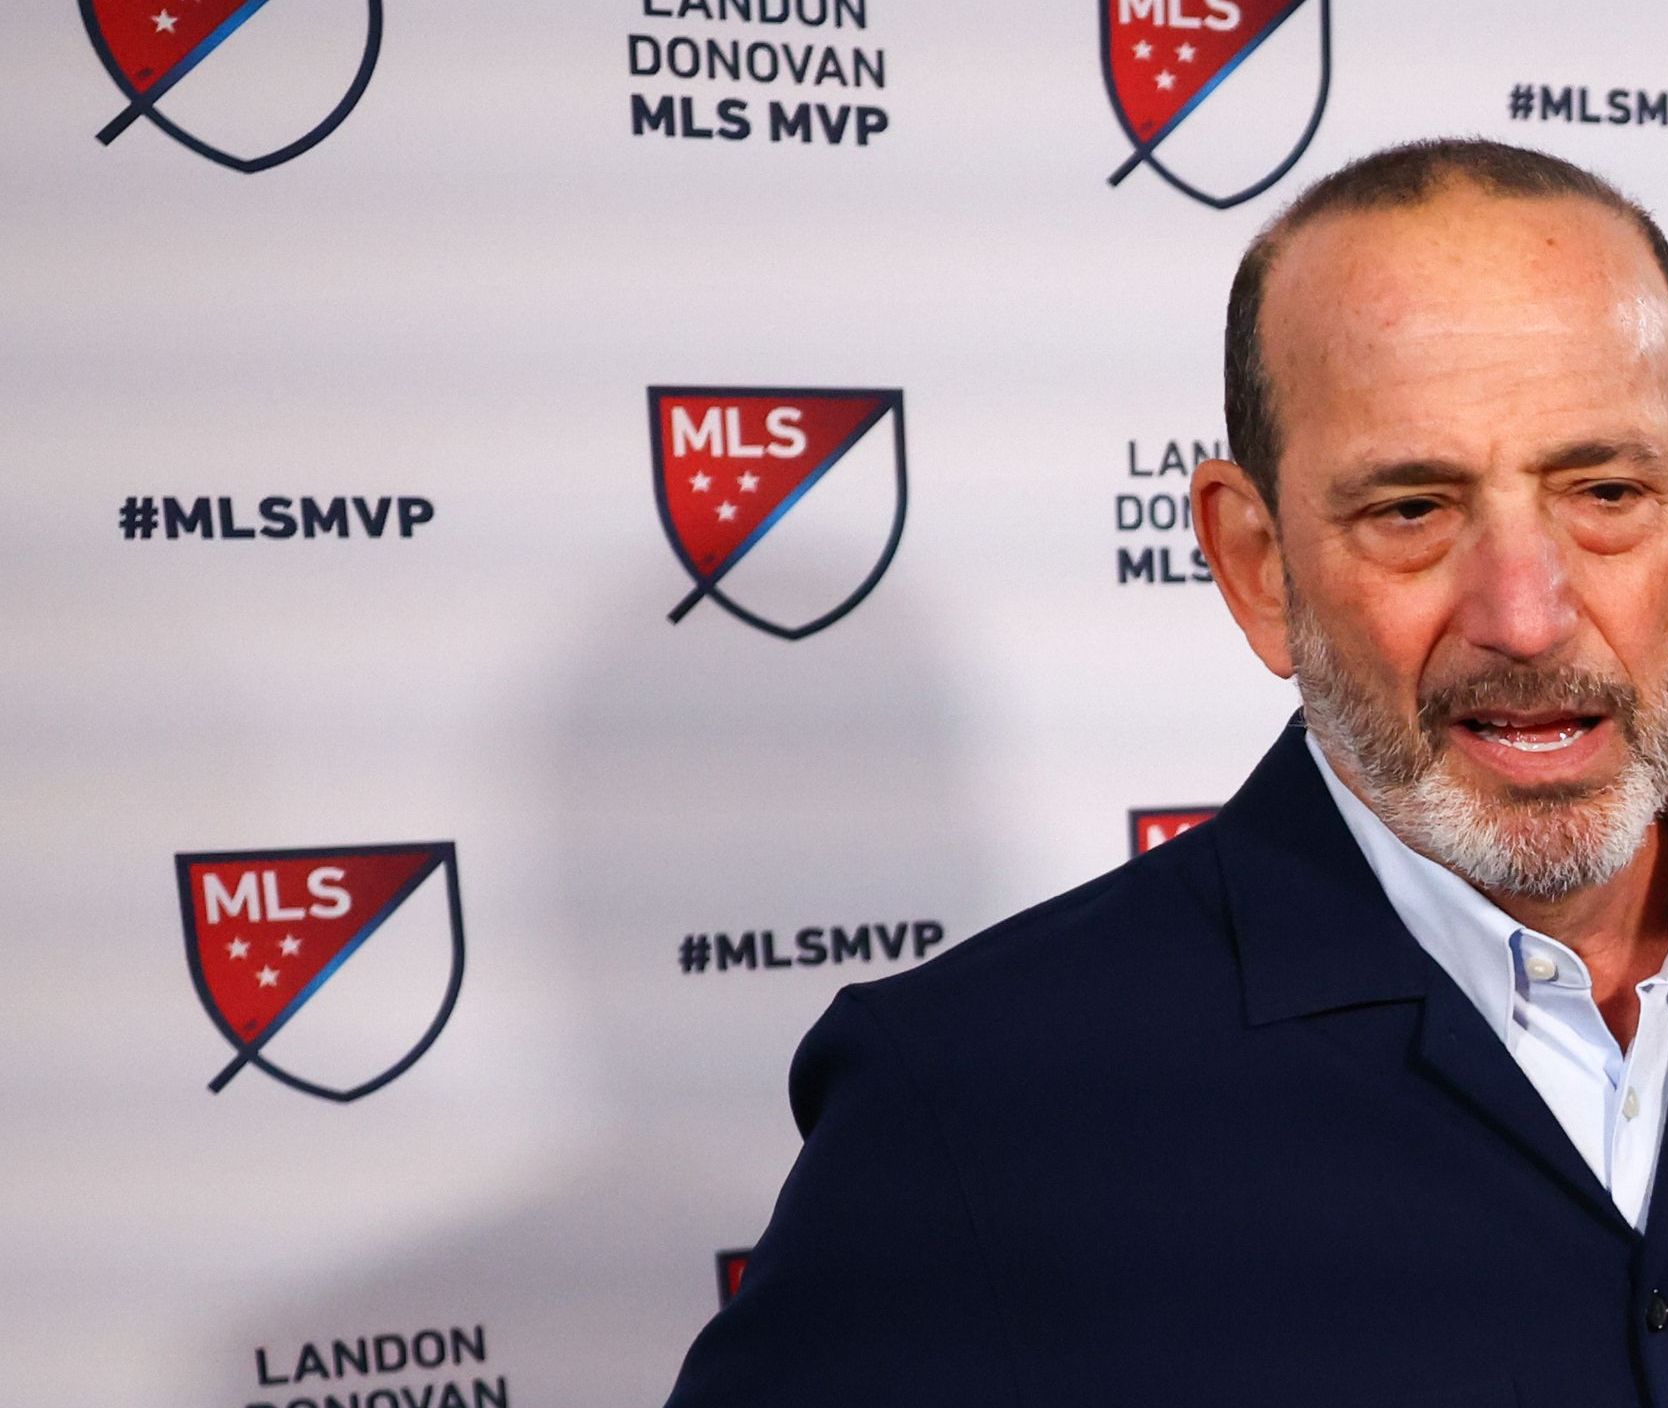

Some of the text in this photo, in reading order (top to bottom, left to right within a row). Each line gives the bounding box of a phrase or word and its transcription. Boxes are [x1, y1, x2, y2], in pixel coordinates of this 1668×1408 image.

[627, 33, 886, 89] DONOVAN
[630, 93, 889, 146] MLS MVP
[671, 406, 807, 459] MLS
[118, 495, 436, 541] #MLSMVP
[203, 866, 352, 925] MLS
[678, 920, 946, 975] #MLSMVP
[255, 1324, 487, 1387] LANDON
